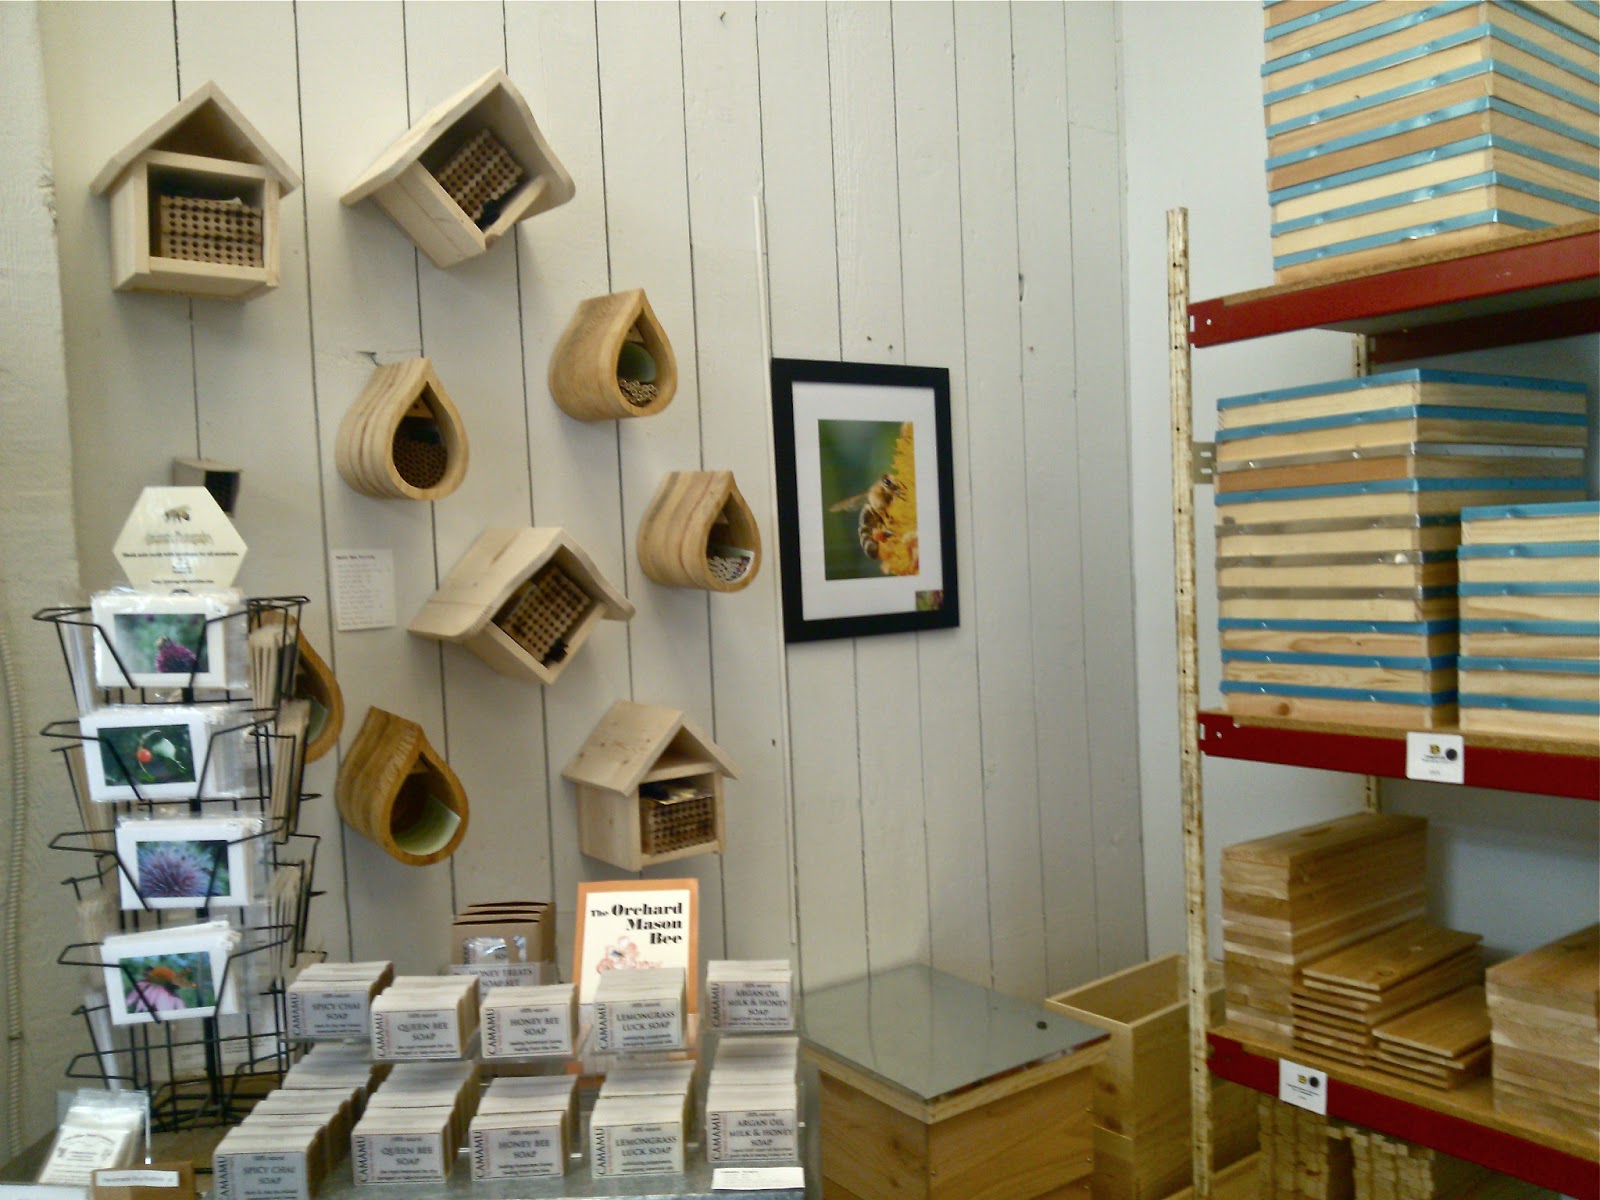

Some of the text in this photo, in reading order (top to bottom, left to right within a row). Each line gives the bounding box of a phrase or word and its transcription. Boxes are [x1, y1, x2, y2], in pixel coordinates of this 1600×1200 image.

[591, 902, 683, 917] The Orchard
[626, 918, 683, 931] Mason
[650, 932, 683, 945] Bee
[711, 984, 720, 1027] CAMAMU
[290, 993, 301, 1036] CAMAMU
[616, 1011, 675, 1022] LEMONGRASS
[397, 1022, 449, 1033] QUEEN BEE
[510, 1017, 560, 1026] HONEY BEE
[598, 1003, 608, 1050] CAMAMU
[622, 1021, 671, 1031] LUCK SOAP
[374, 1013, 386, 1057] CAMAMU
[411, 1033, 436, 1041] SOAP
[485, 1008, 497, 1055] CAMAMU
[524, 1027, 547, 1035] SOAP
[738, 1119, 768, 1127] ARGAN
[711, 1113, 721, 1160] CAMAMU
[729, 1129, 752, 1137] MILK
[762, 1128, 794, 1136] HONEY
[498, 1139, 550, 1149] HONEY BEE
[615, 1136, 677, 1147] LEMONGRASS
[380, 1146, 433, 1156] QUEEN BEE
[474, 1131, 485, 1178] CAMAMU
[513, 1150, 537, 1159] SOAP
[595, 1128, 606, 1175] CAMAMU
[621, 1146, 673, 1157] LUCK SOAP
[356, 1136, 368, 1183] CAMAMU
[217, 1156, 229, 1197] AMAMU
